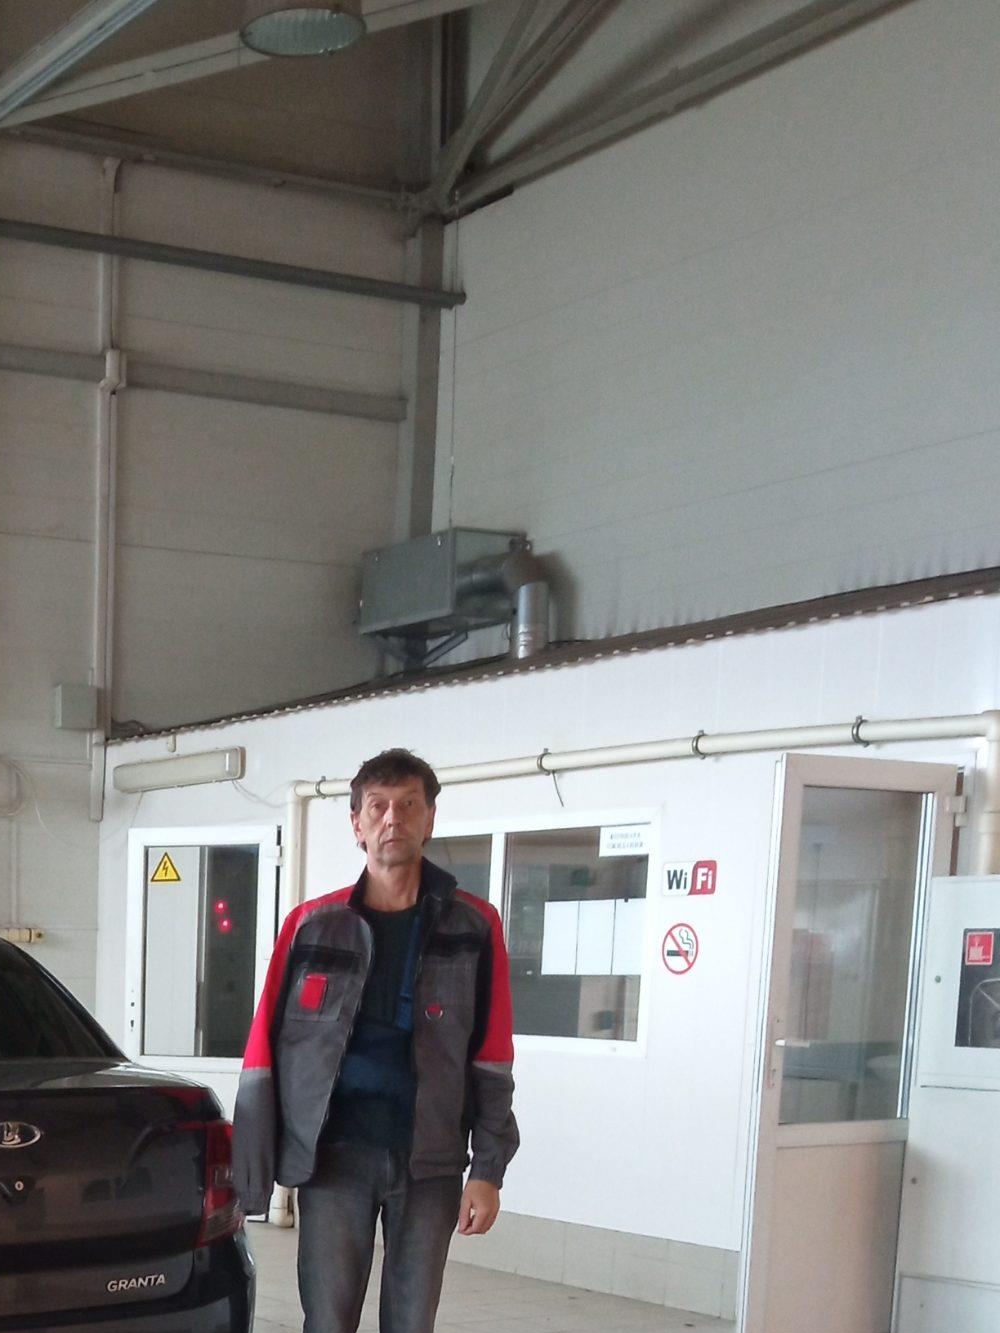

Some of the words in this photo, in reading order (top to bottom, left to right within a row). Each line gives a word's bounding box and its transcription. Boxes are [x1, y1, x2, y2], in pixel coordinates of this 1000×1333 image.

[666, 868, 688, 891] Wi
[695, 866, 714, 891] Fi
[107, 1274, 167, 1293] GRANTA
